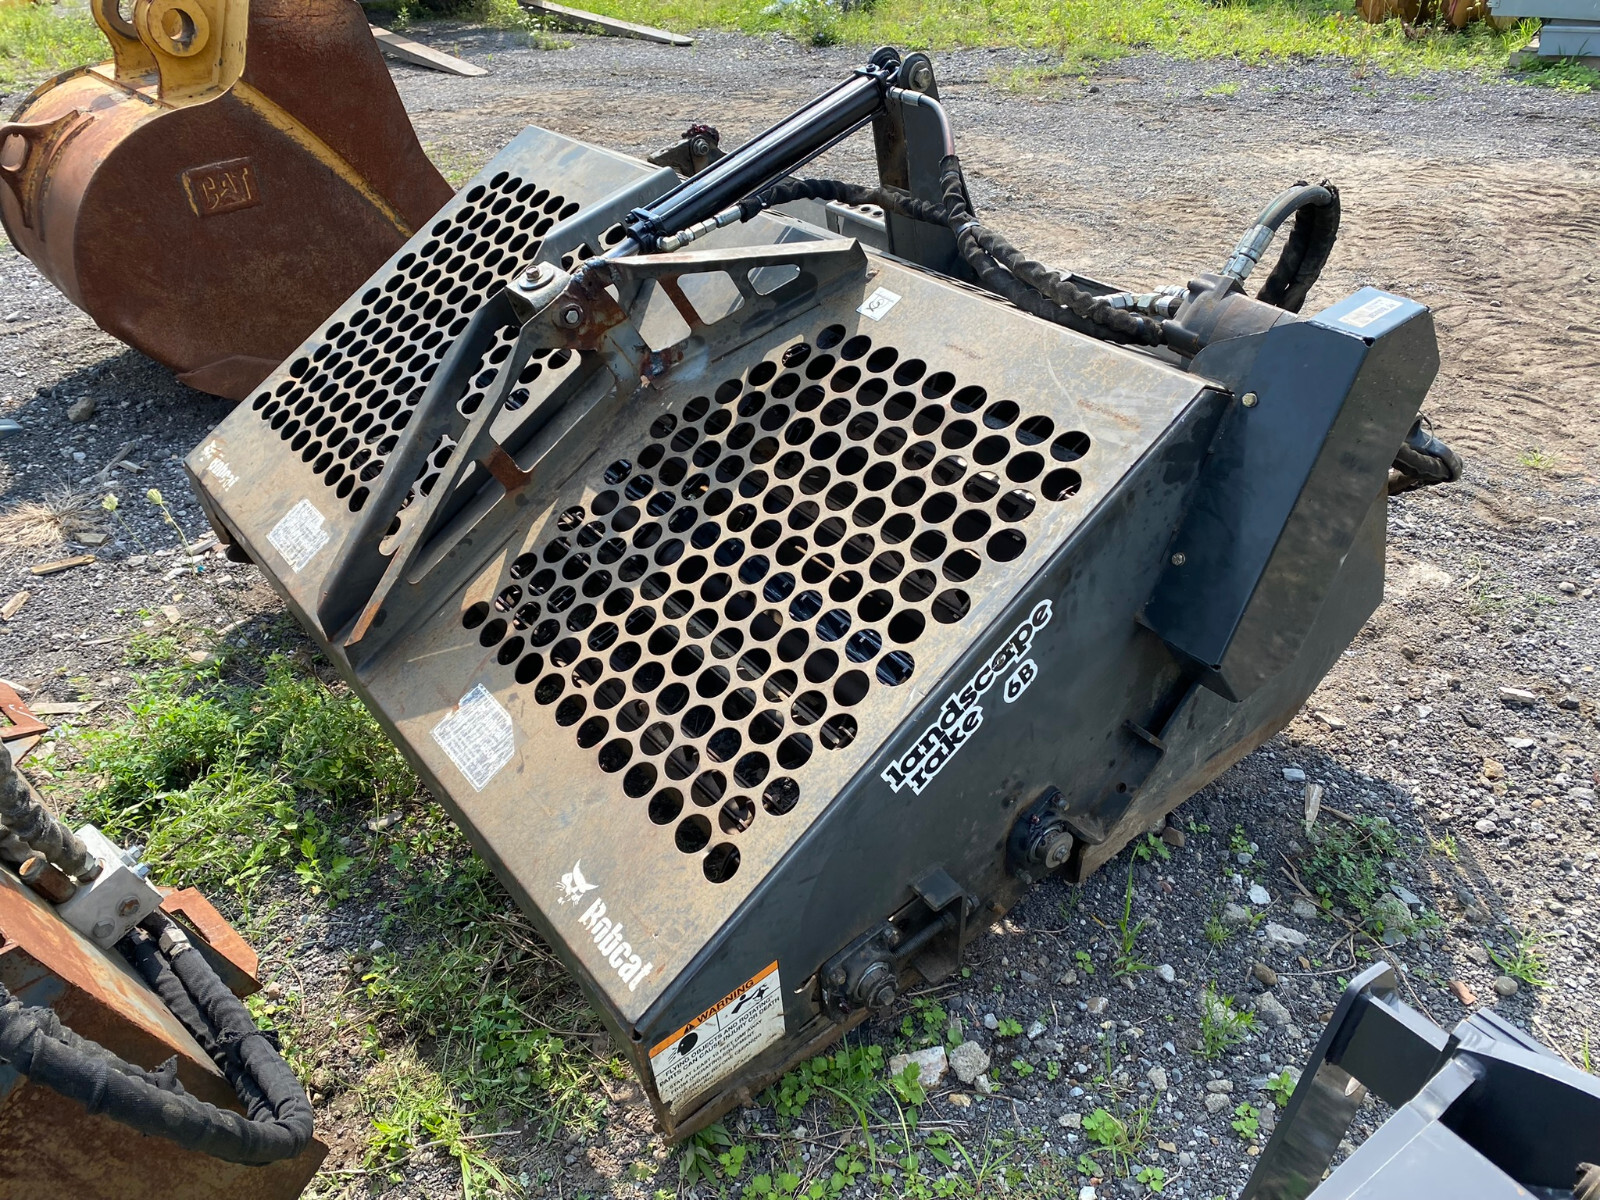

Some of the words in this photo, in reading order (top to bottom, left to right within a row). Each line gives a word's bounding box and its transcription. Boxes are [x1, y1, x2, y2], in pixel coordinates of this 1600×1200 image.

[202, 167, 253, 210] CAT
[884, 603, 1050, 787] landscape
[1005, 662, 1036, 699] 6B
[909, 709, 981, 791] rake
[577, 897, 653, 992] Bobcat
[697, 978, 753, 1024] WARNING
[659, 1068, 681, 1087] PARTS
[682, 1056, 697, 1070] CAN
[699, 1039, 721, 1058] CAUSE
[723, 1020, 746, 1040] INJURY
[747, 1012, 757, 1022] OR
[759, 996, 779, 1014] DEATH
[665, 1055, 689, 1077] FLYING
[691, 1032, 722, 1058] OBJECTS
[723, 1020, 737, 1034] AND
[738, 997, 770, 1023] ROTATING
[669, 1076, 683, 1089] STAY
[684, 1070, 691, 1078] AT
[693, 1056, 710, 1071] LEAST
[719, 1040, 732, 1052] FEET
[746, 1018, 761, 1032] AWAY
[671, 1079, 687, 1094] FROM
[689, 1055, 721, 1081] OPERATING
[722, 1030, 754, 1056] EQUIPMENT
[688, 1070, 709, 1088] ENGINE
[711, 1053, 732, 1072] BEFORE
